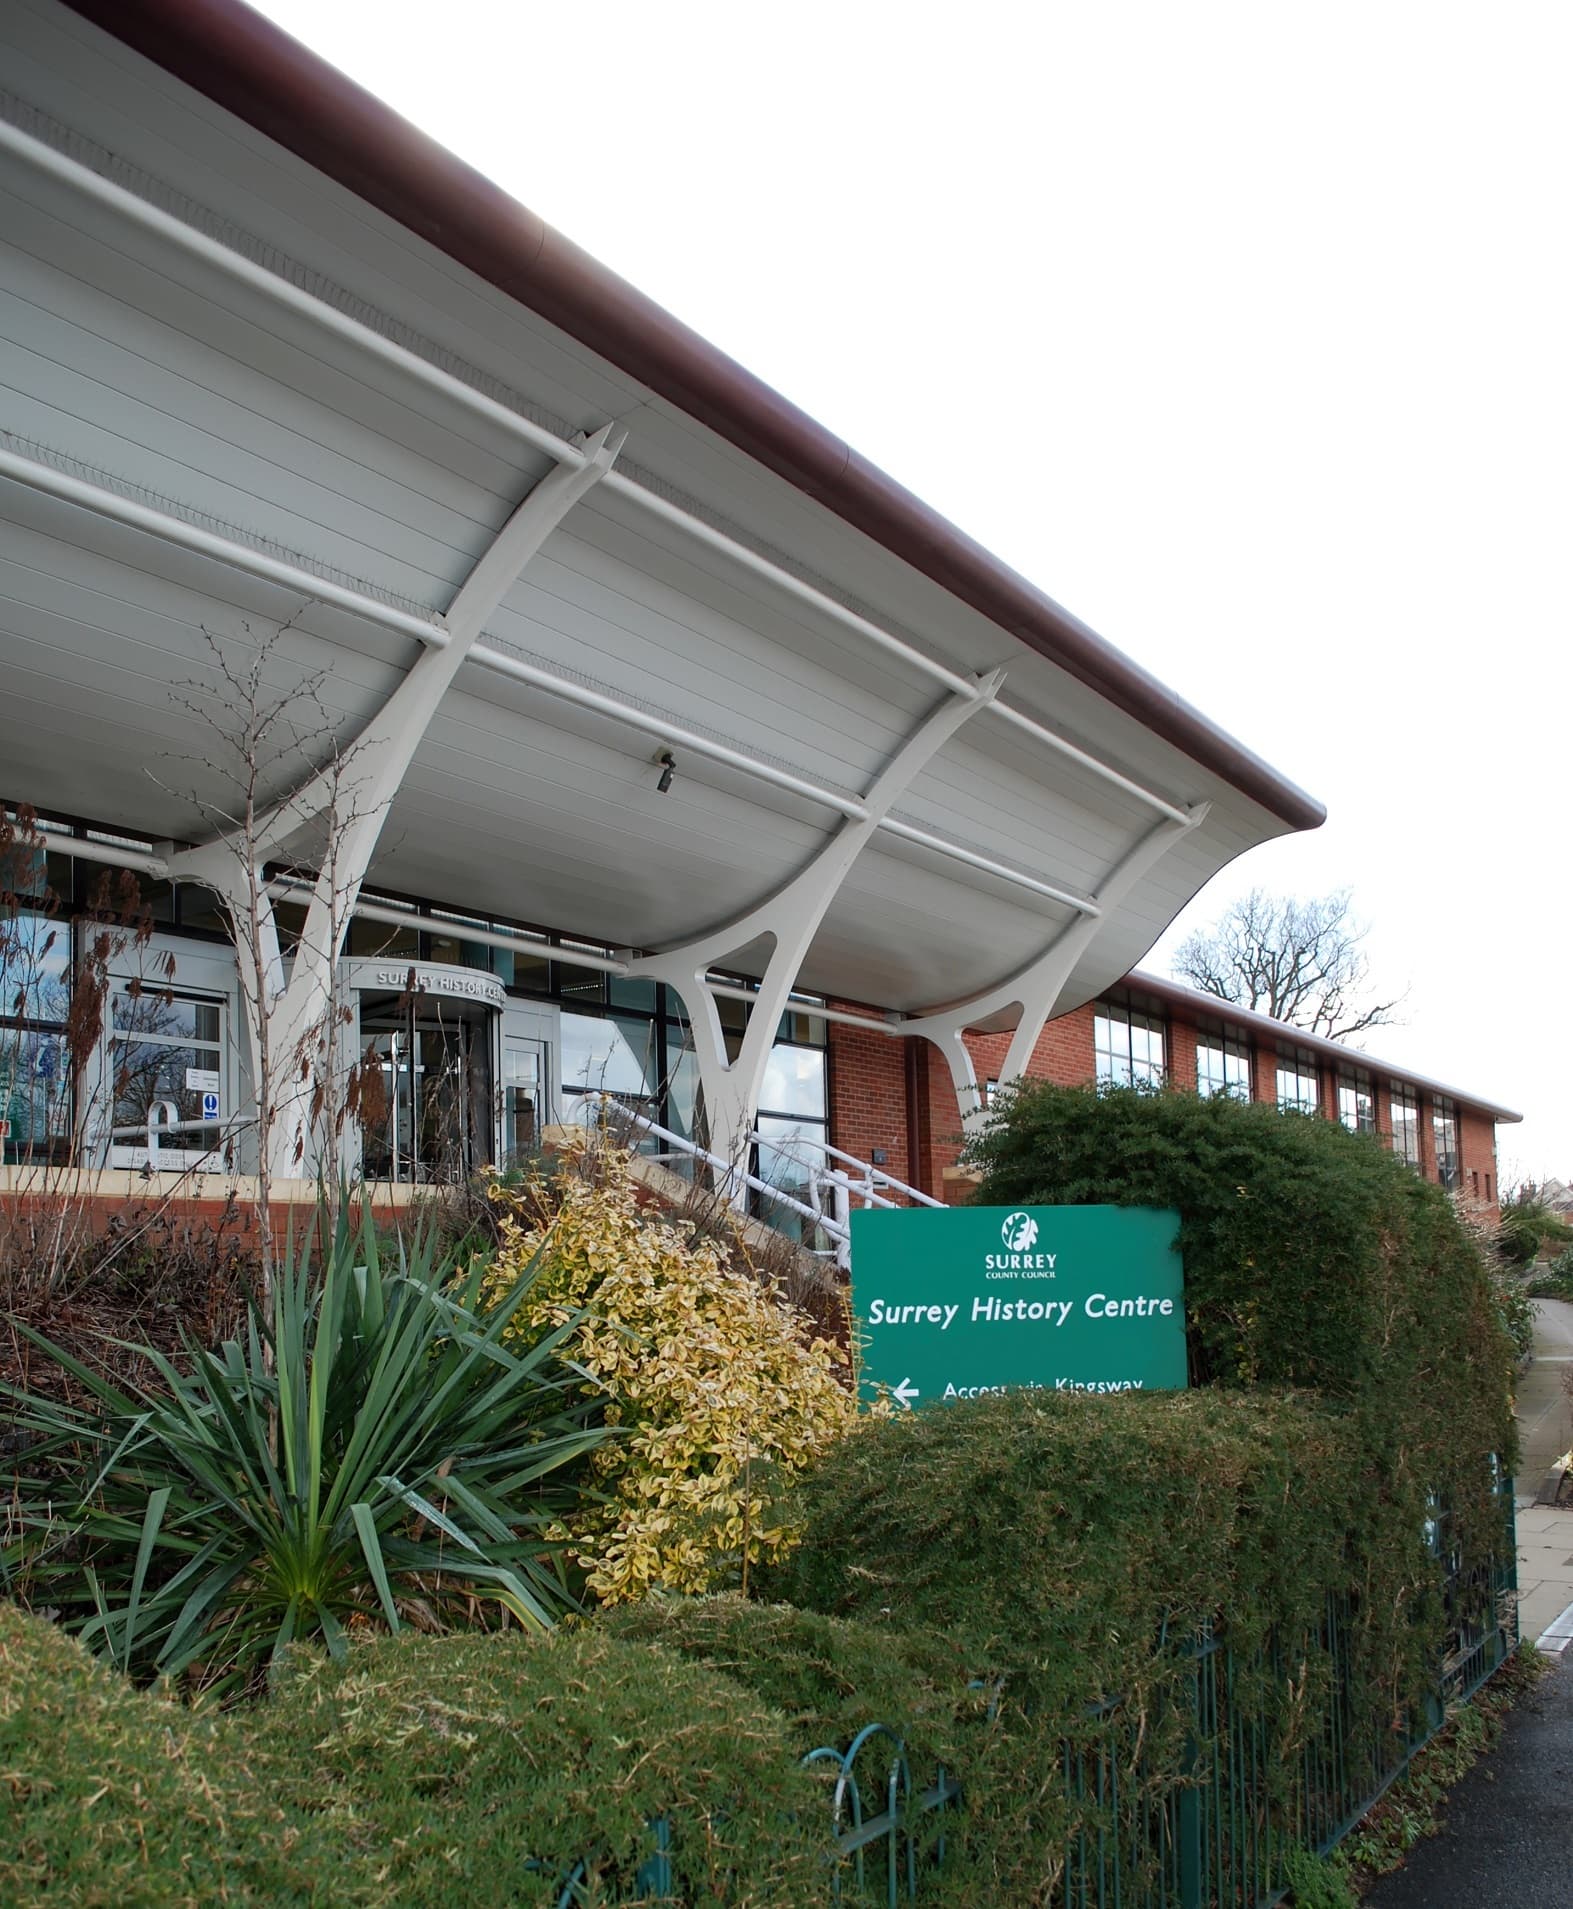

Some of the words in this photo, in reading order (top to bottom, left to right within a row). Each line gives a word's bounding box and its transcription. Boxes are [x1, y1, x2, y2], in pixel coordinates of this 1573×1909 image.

[440, 976, 486, 995] HISTORY
[985, 1254, 1056, 1269] SURREY
[985, 1271, 1018, 1279] COUNTY
[1021, 1271, 1056, 1279] COUNCIL
[868, 1299, 959, 1330] Surrey
[971, 1296, 1073, 1326] History
[1084, 1293, 1174, 1318] Centre
